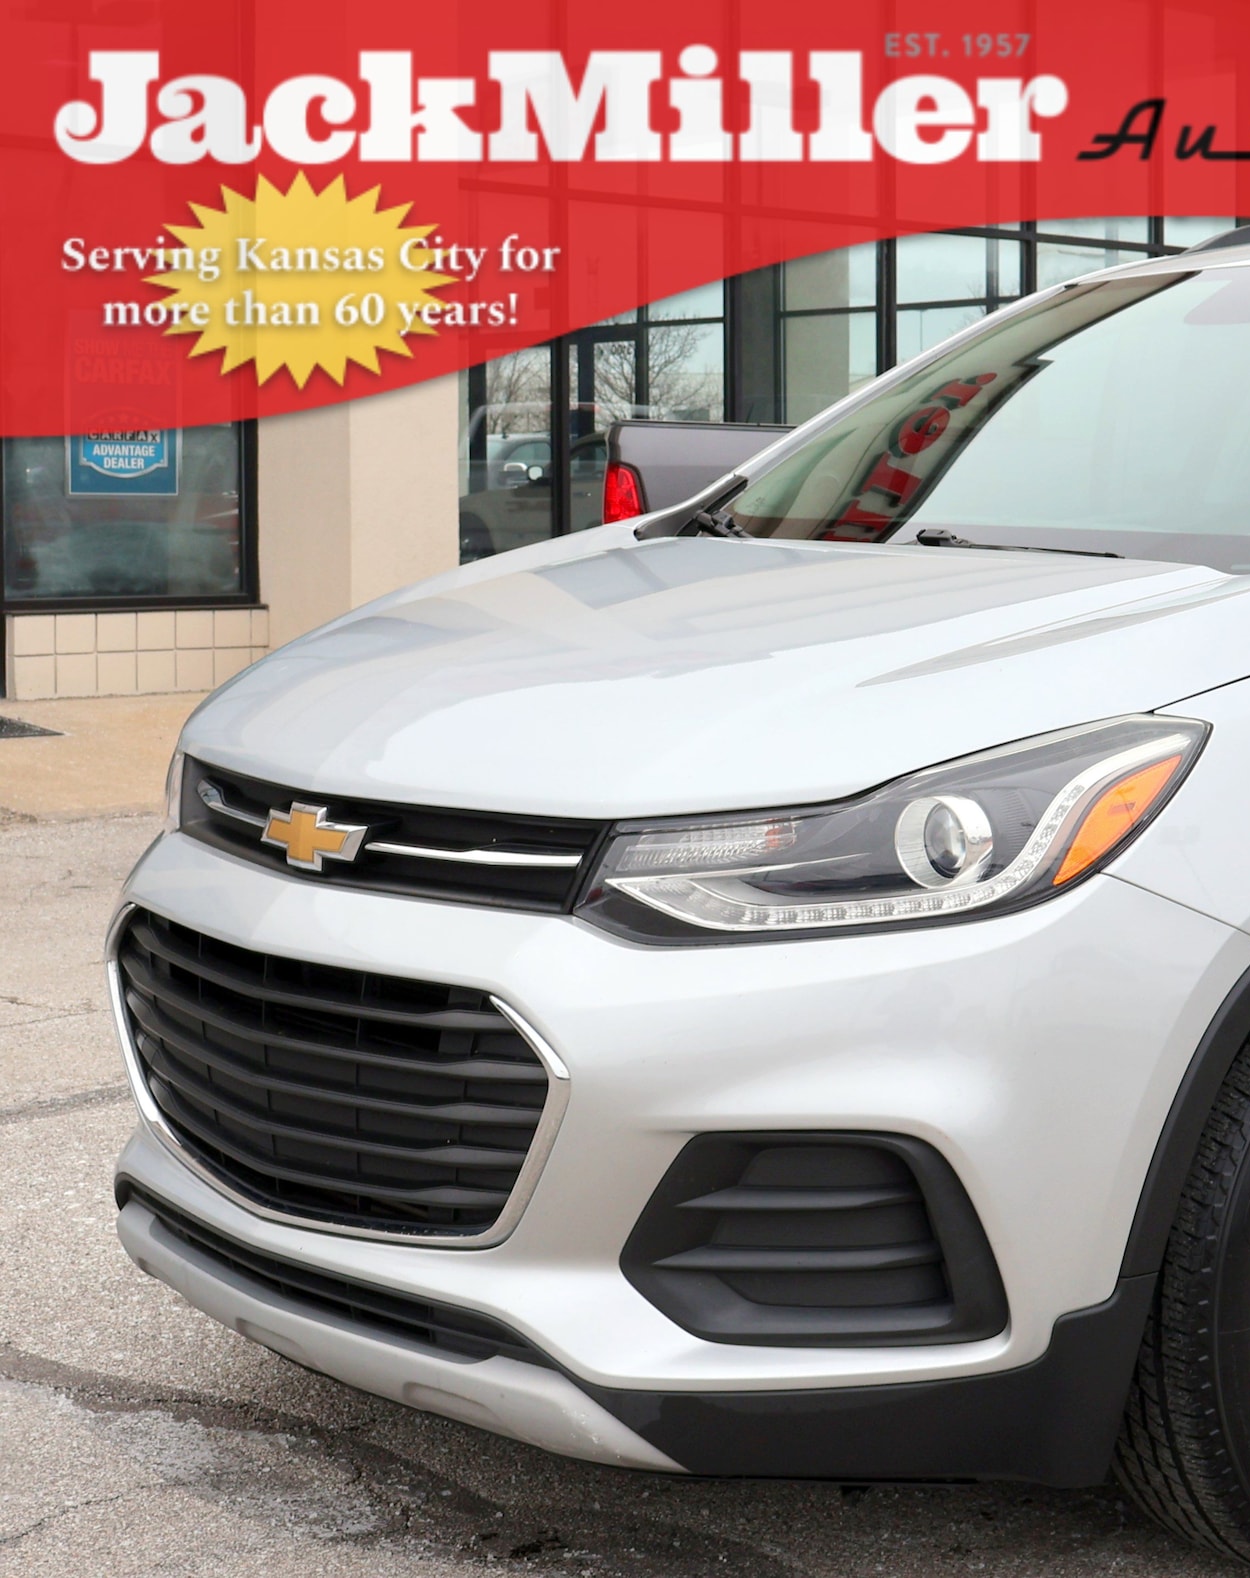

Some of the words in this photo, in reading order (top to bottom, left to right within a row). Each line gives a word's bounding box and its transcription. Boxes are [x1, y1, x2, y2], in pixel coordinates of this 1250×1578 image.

[75, 356, 172, 385] CARFAX
[93, 444, 155, 457] ADVANTAGE
[103, 457, 145, 469] DEALER
